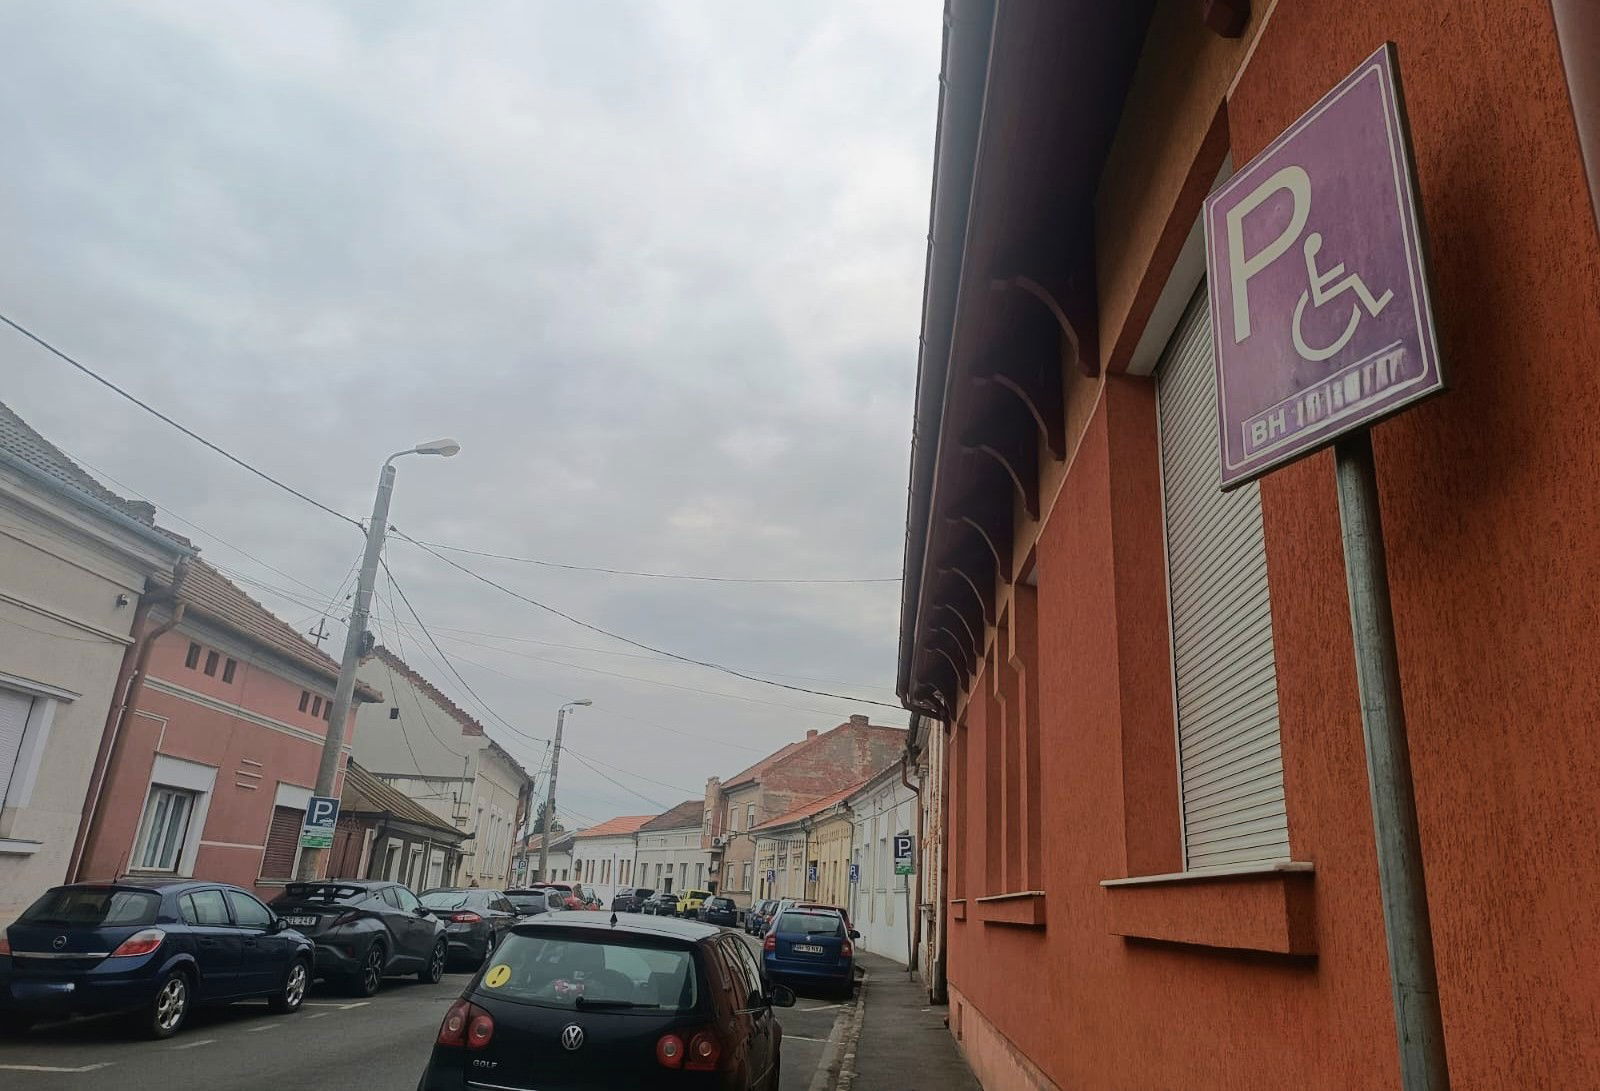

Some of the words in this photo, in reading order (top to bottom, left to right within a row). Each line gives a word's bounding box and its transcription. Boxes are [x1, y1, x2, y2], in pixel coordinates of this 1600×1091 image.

[1226, 165, 1312, 344] P
[1251, 407, 1286, 448] BH
[312, 800, 333, 824] P
[898, 838, 911, 857] P
[472, 1059, 498, 1069] GOLF
